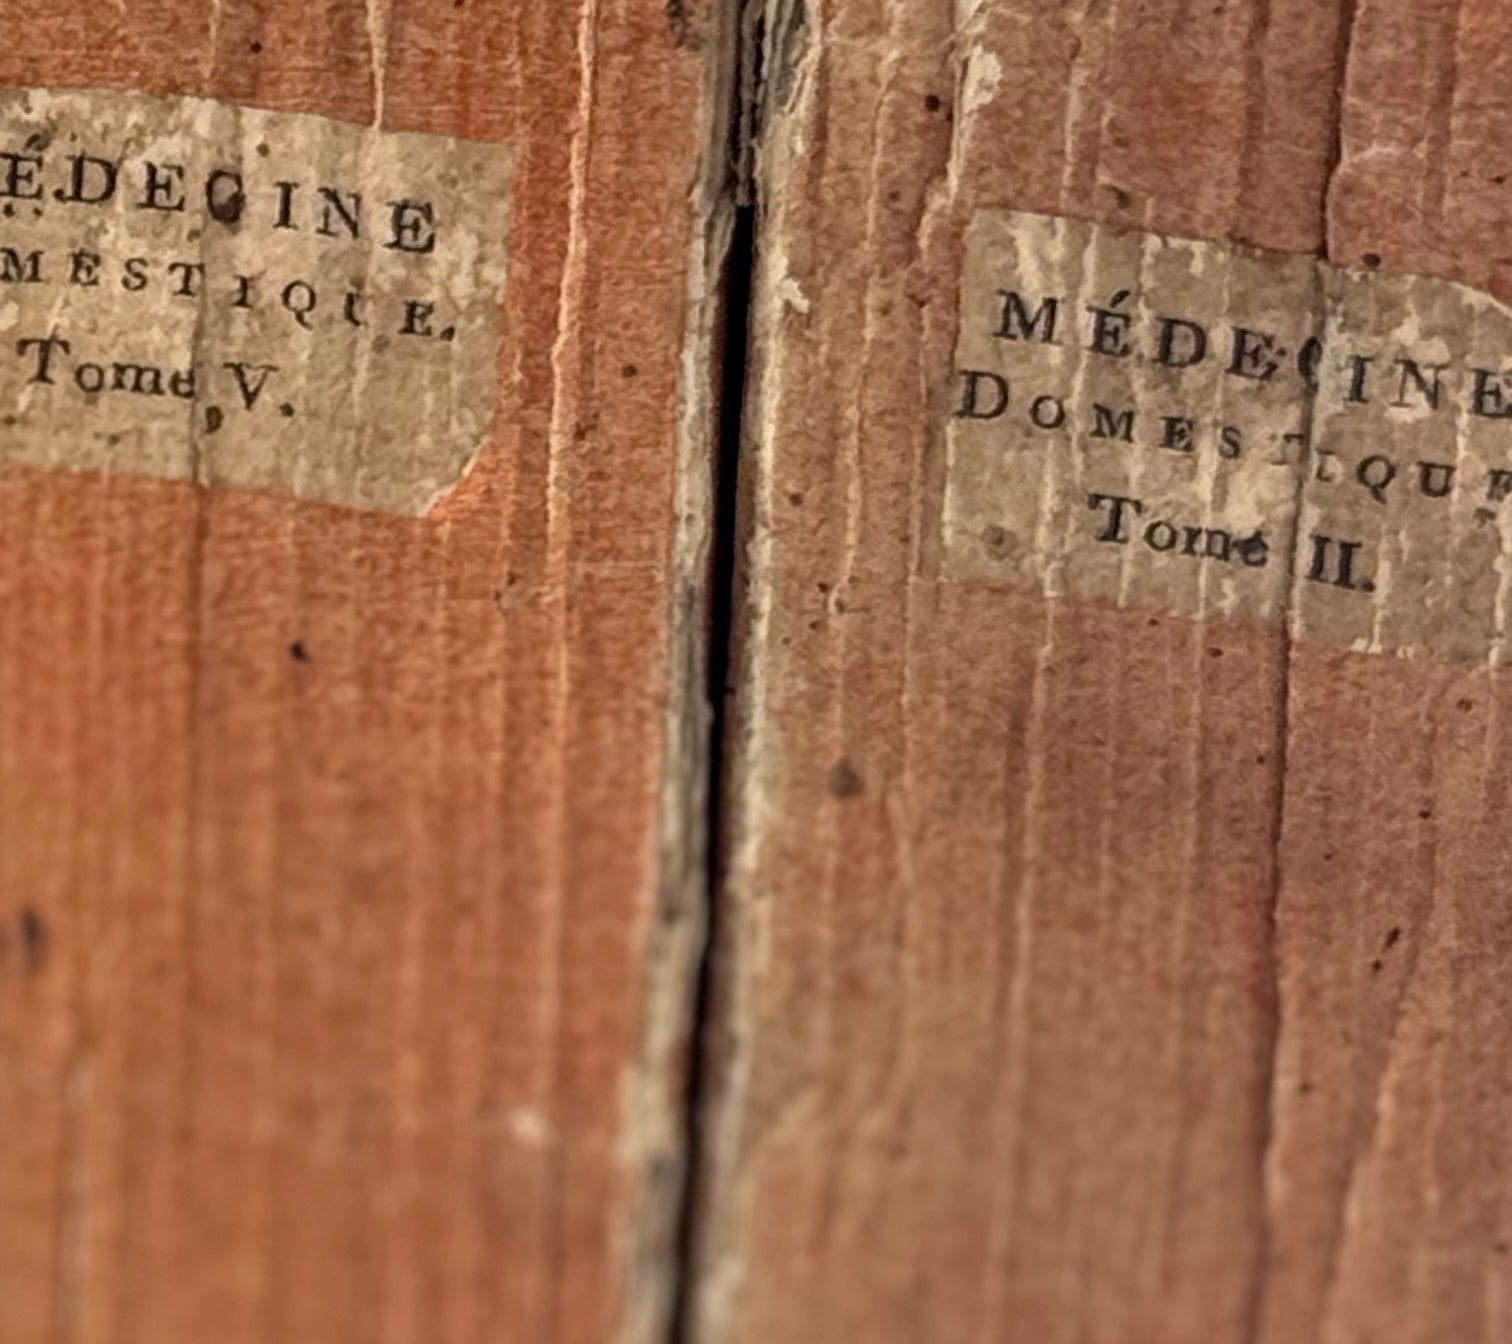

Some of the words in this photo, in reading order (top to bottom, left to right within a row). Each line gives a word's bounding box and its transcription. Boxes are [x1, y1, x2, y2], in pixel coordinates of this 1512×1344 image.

[16, 336, 196, 400] Tome
[224, 361, 295, 417] V.
[1089, 492, 1269, 567] Tome
